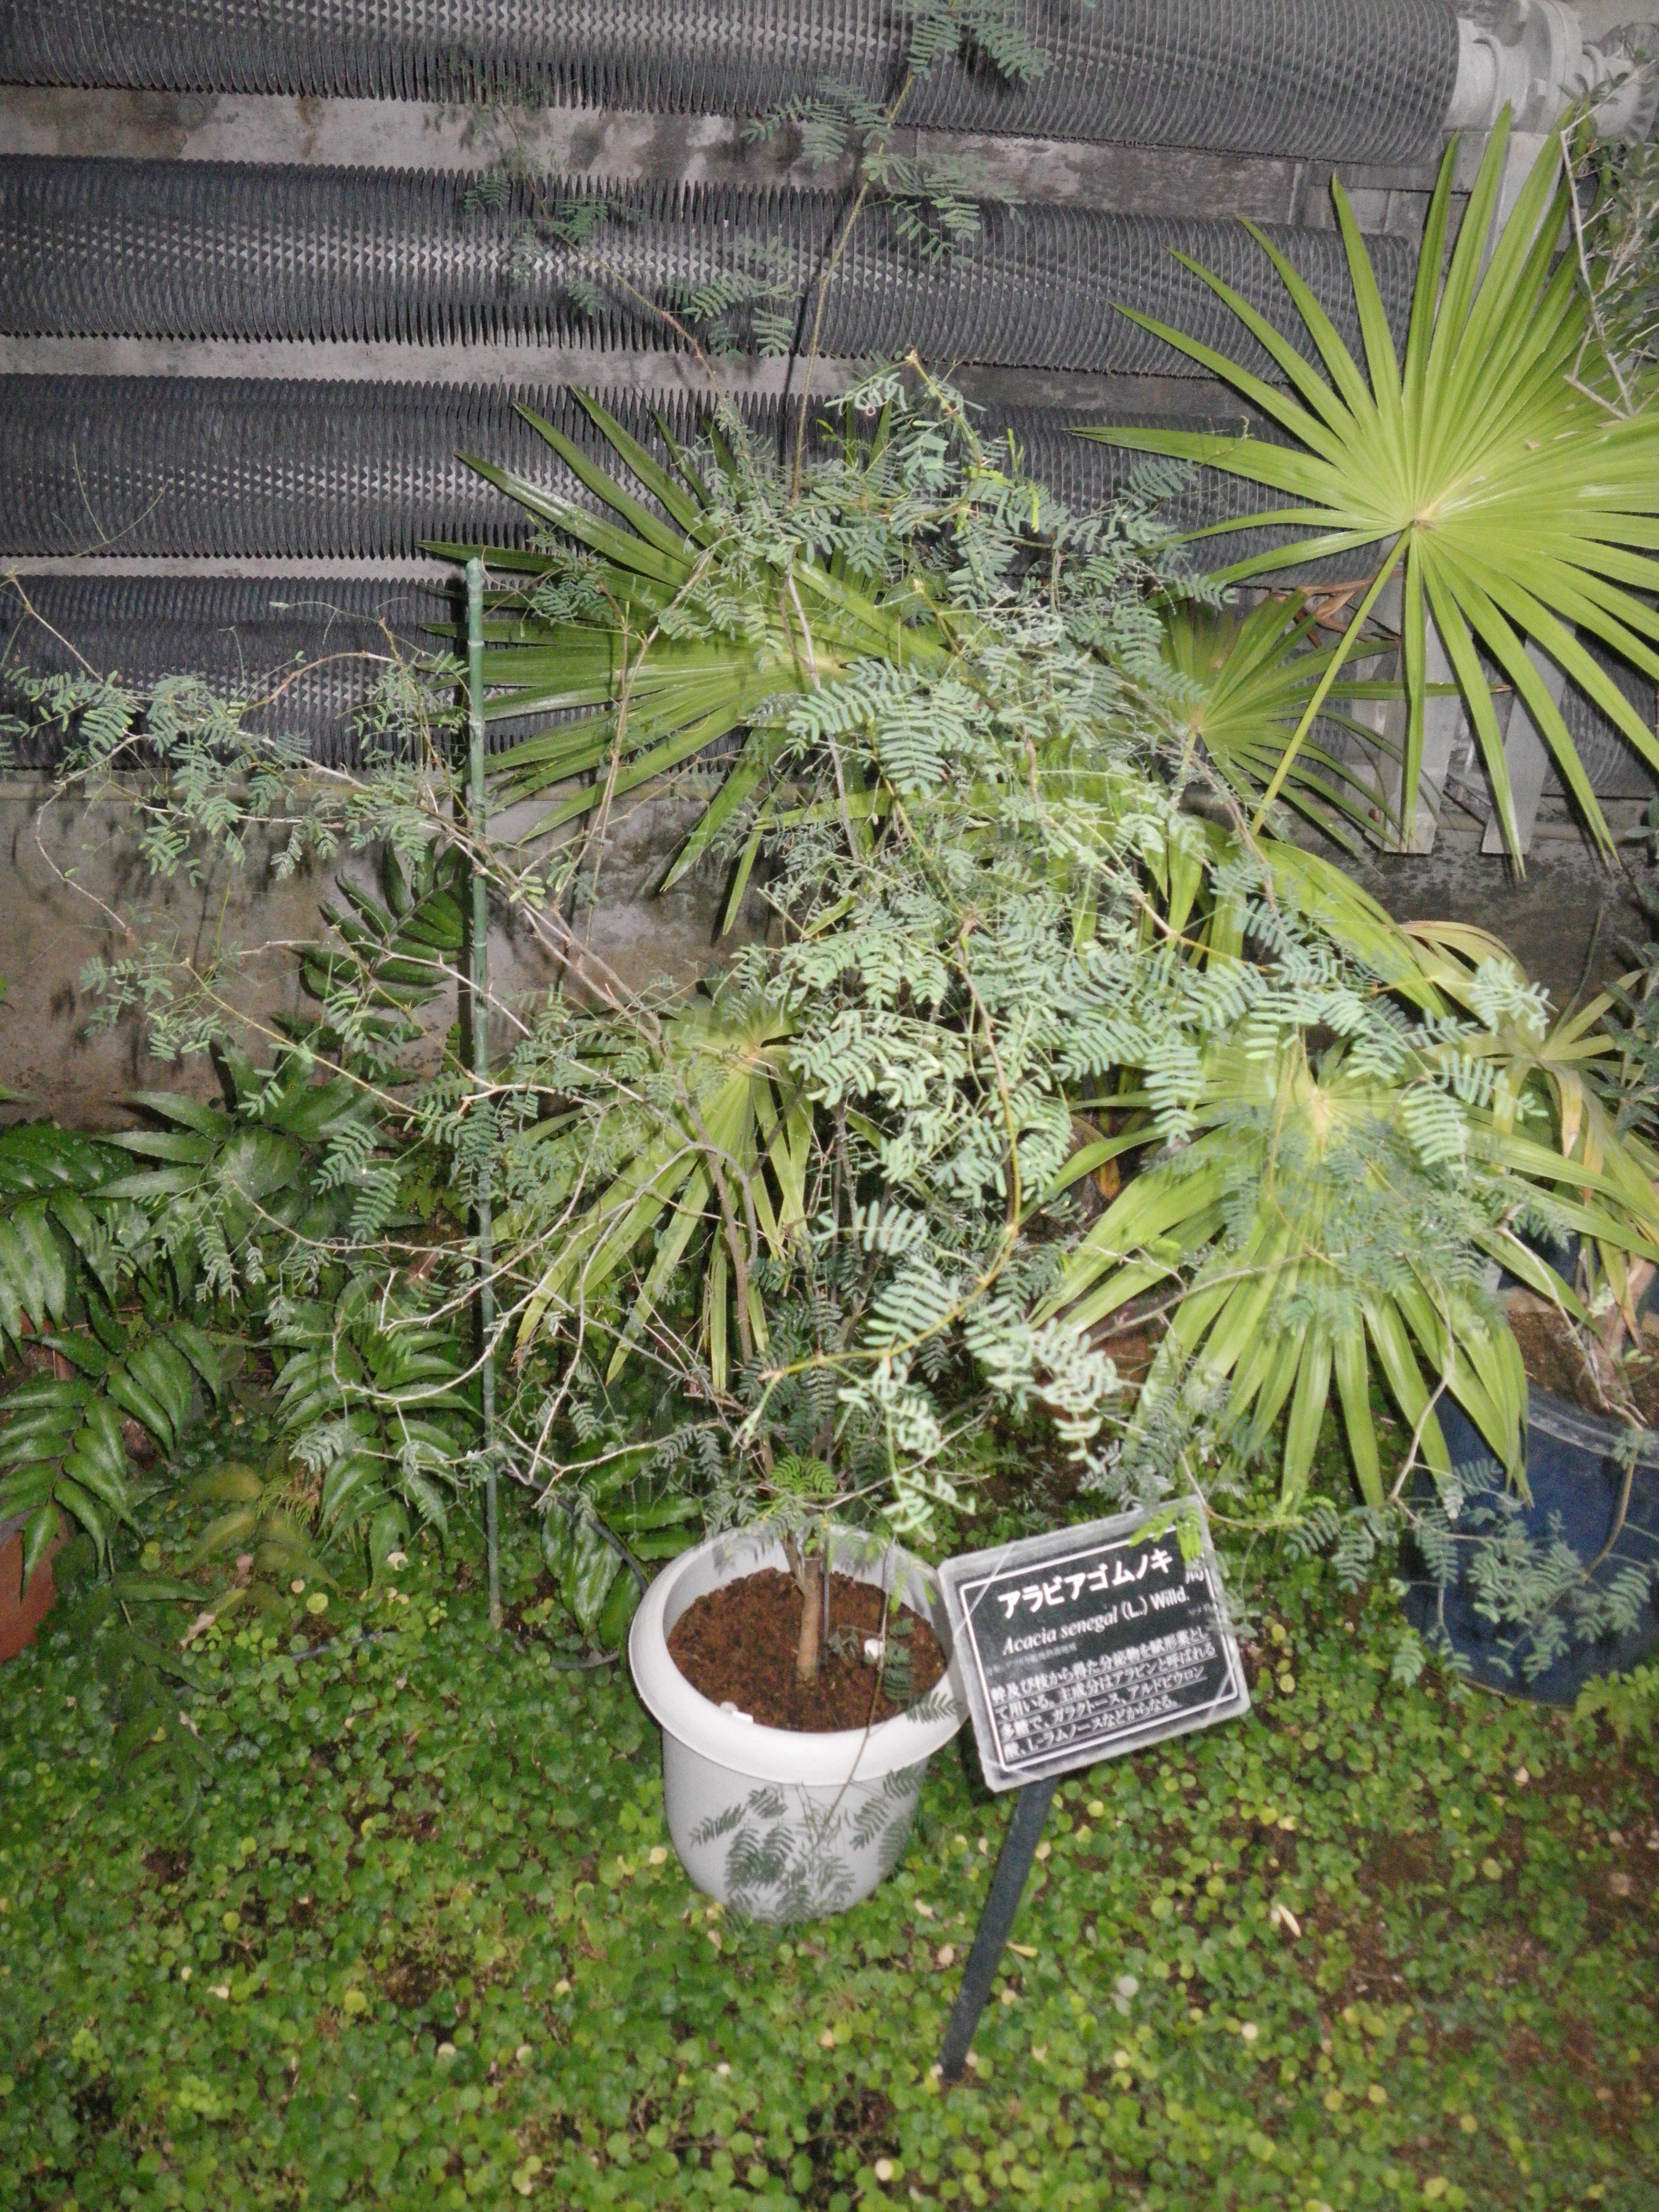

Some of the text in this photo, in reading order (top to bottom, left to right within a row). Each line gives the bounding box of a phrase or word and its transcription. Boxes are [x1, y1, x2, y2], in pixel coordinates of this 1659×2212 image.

[998, 1548, 1173, 1619] アラビアゴムノキ
[1003, 1627, 1057, 1656] Acacia
[1060, 1605, 1118, 1633] senegal
[1150, 1585, 1190, 1610] Willd.
